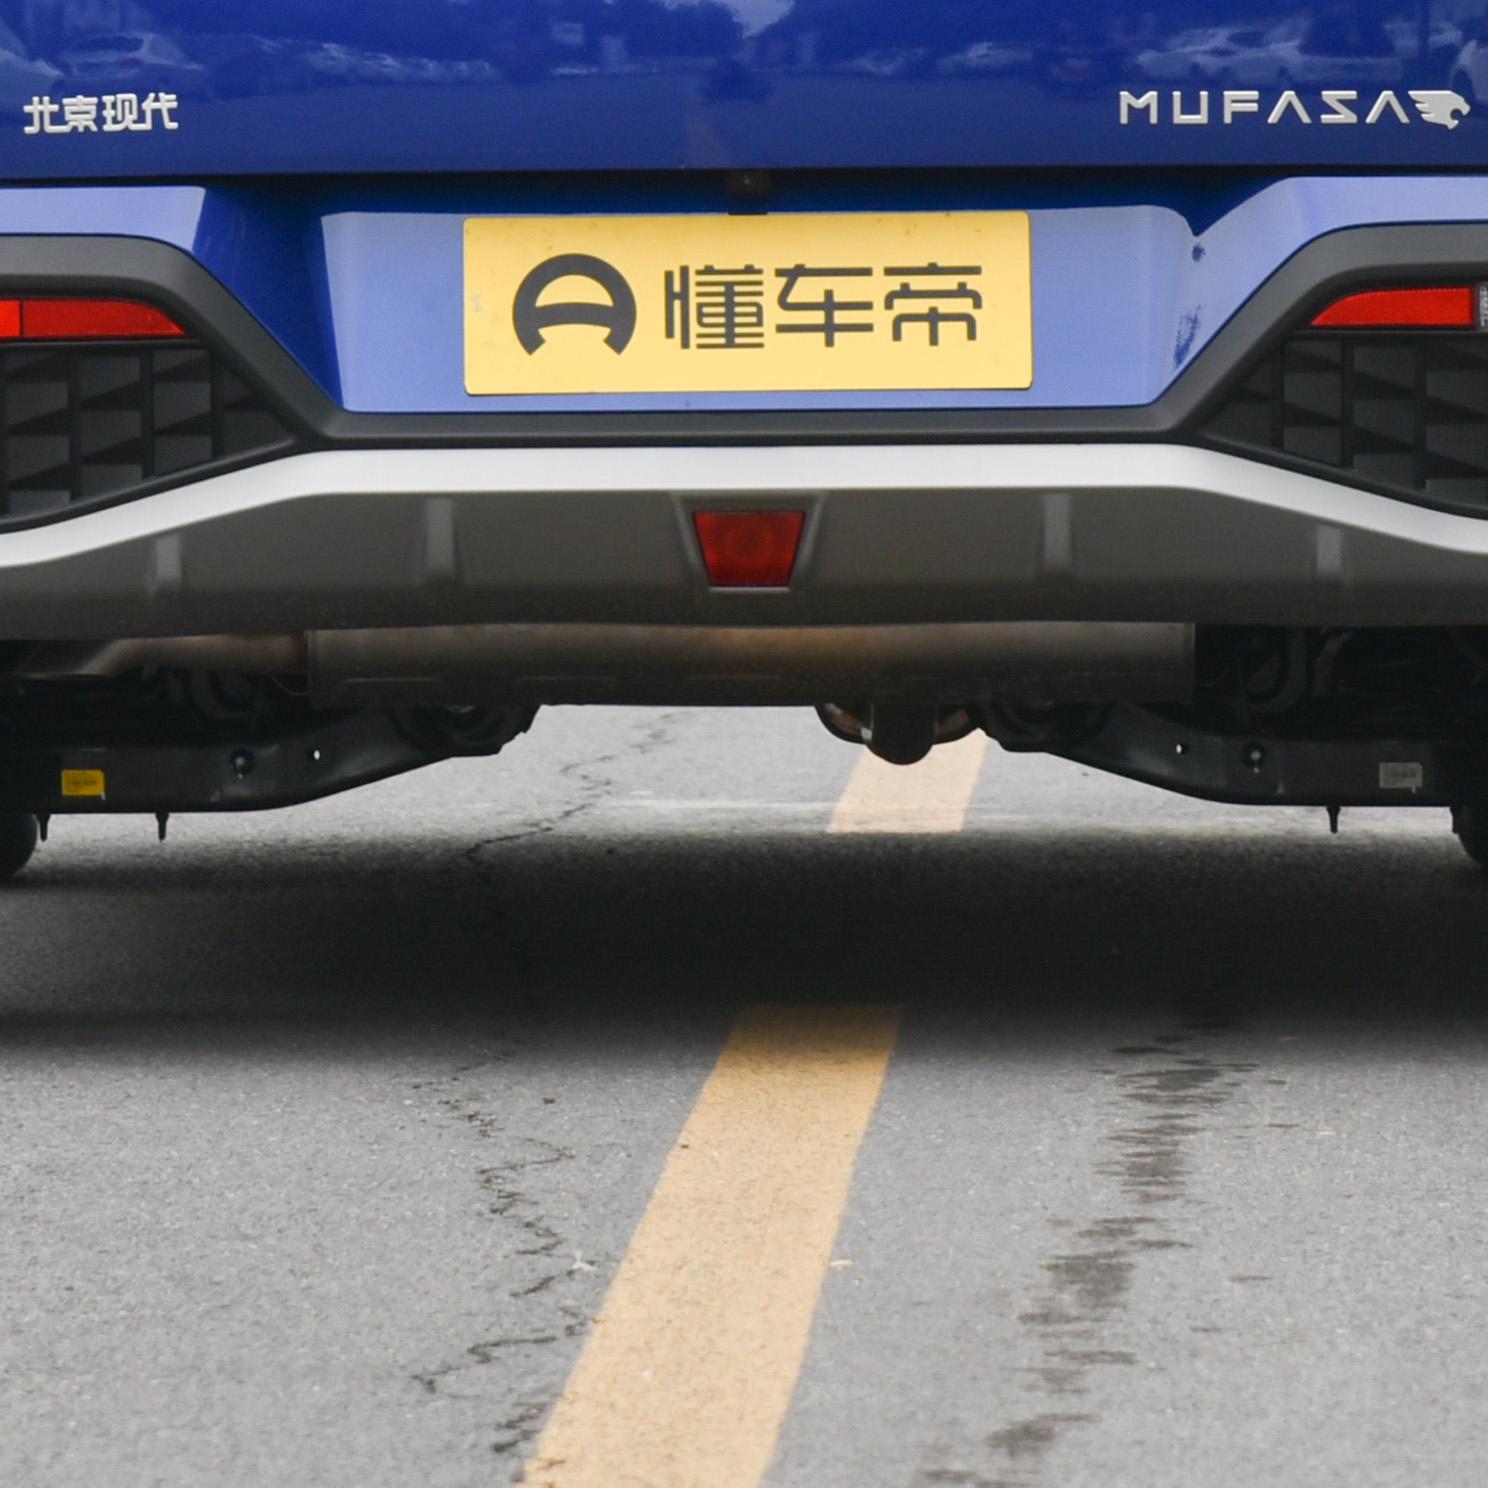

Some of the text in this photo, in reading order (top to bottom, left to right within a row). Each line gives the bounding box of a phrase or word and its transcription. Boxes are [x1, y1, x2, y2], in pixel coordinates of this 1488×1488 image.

[22, 91, 180, 135] 北京现代
[1118, 89, 1411, 126] MUFASA
[663, 262, 983, 350] 懂车帝
